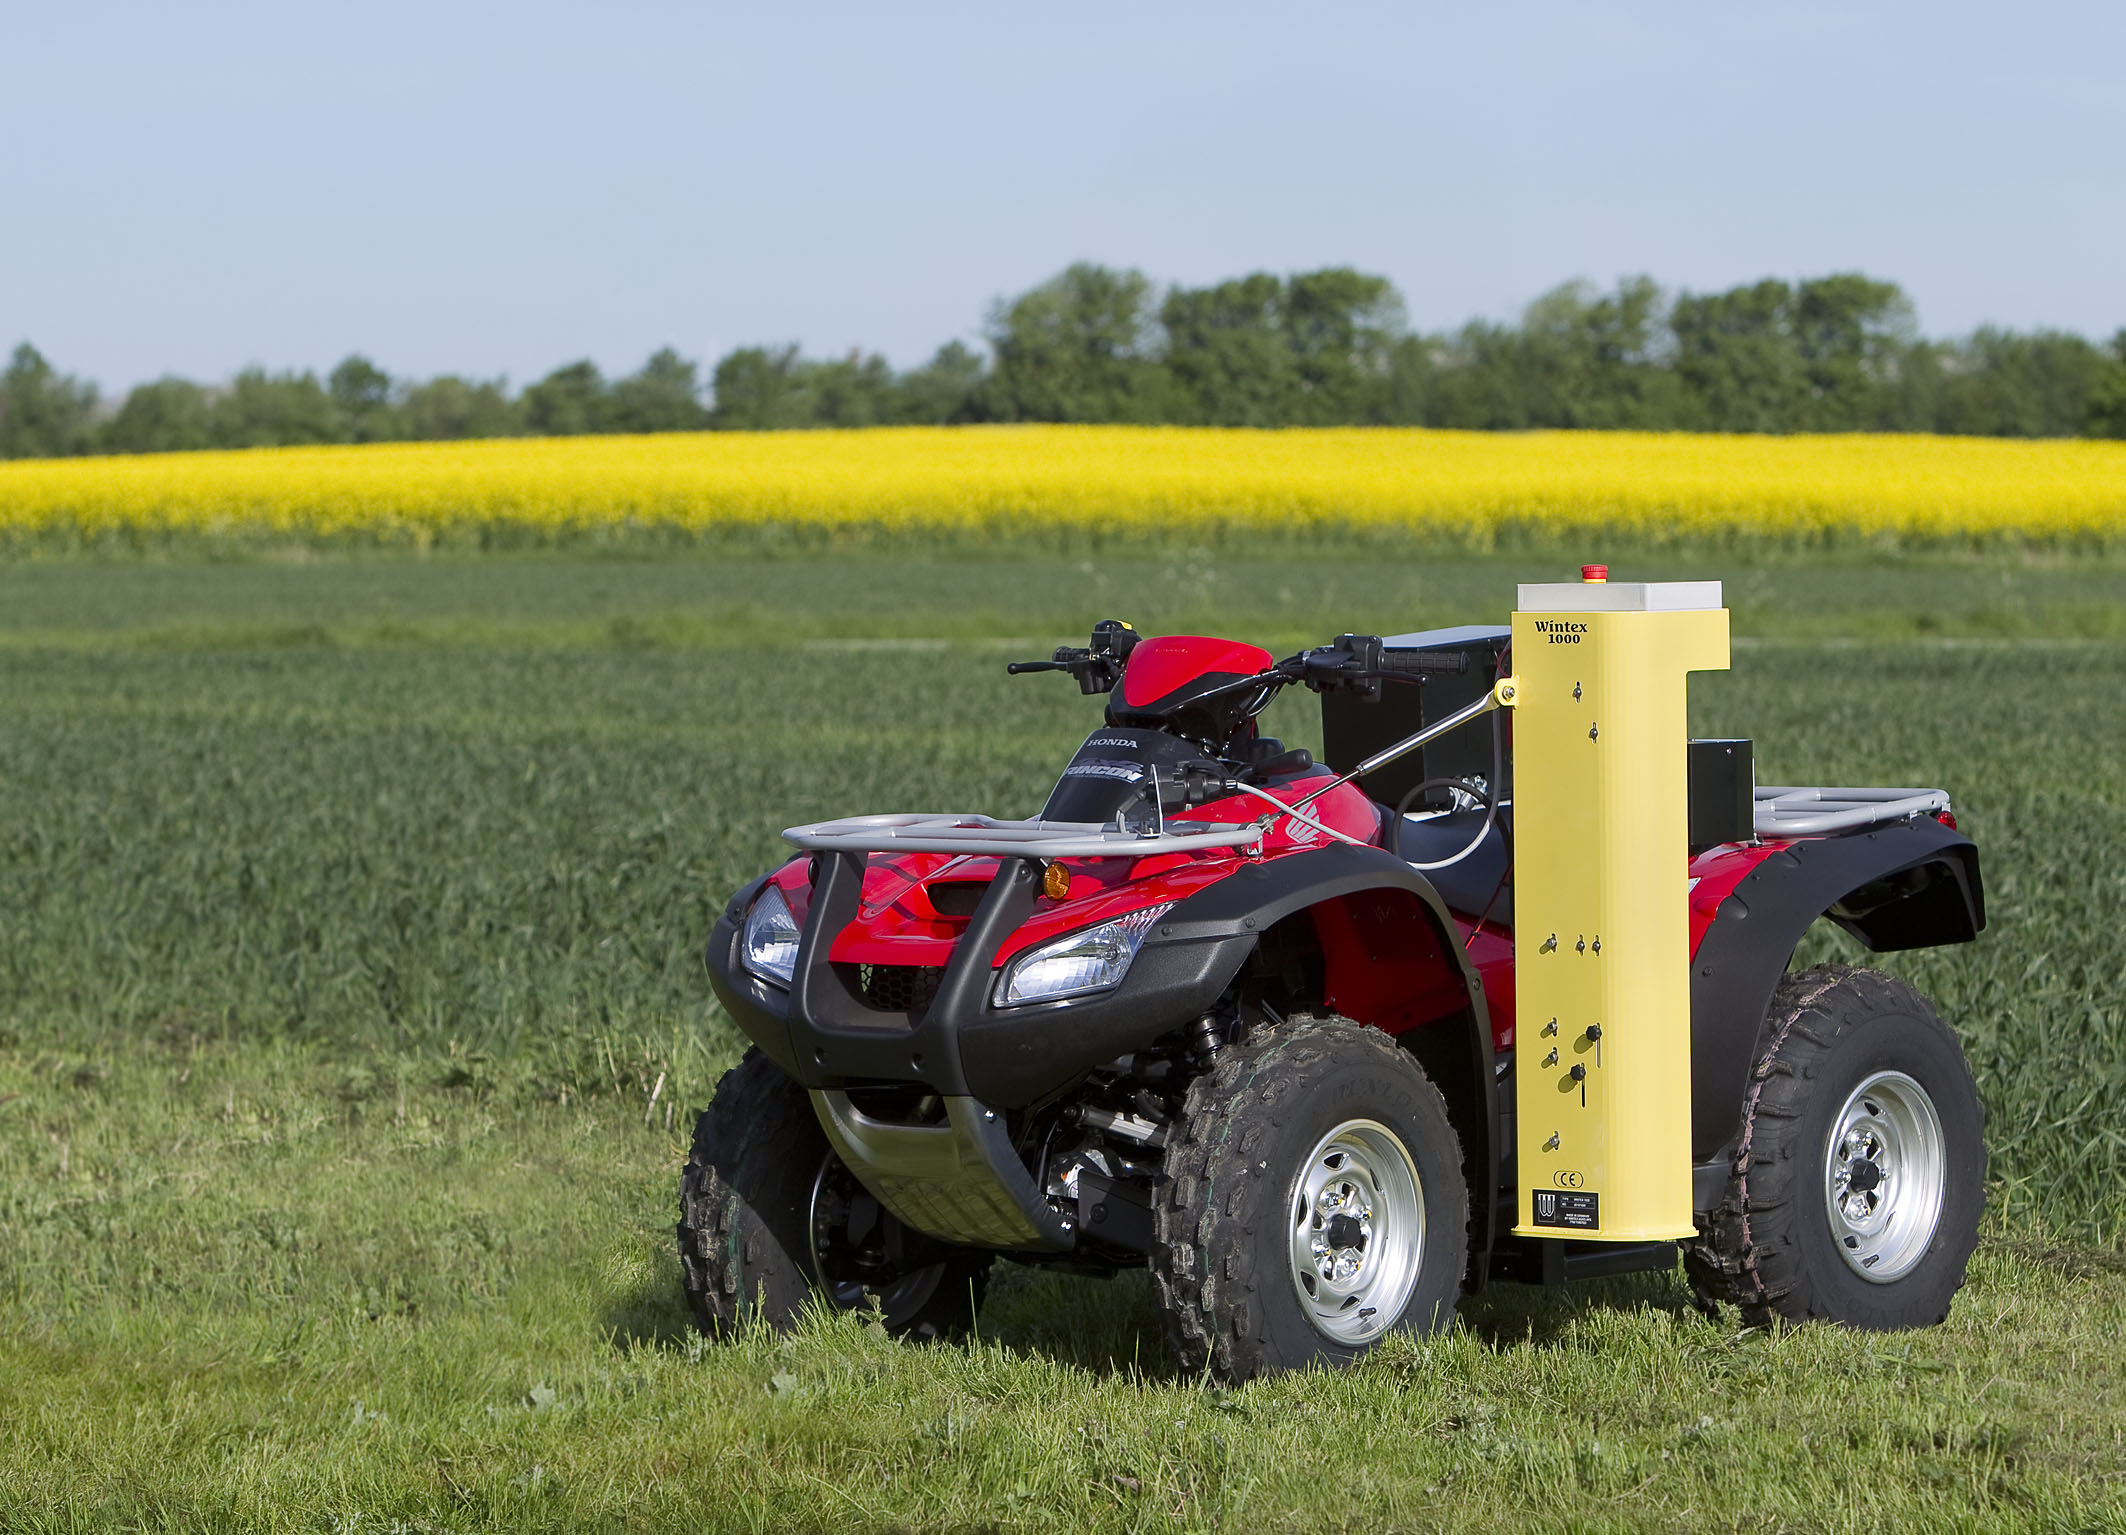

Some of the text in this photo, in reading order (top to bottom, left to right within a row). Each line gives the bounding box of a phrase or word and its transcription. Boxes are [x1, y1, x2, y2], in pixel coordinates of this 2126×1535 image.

[1534, 619, 1588, 633] Wintex
[1548, 633, 1581, 644] 1000
[1087, 738, 1138, 749] HONDA
[1560, 1172, 1576, 1187] CE
